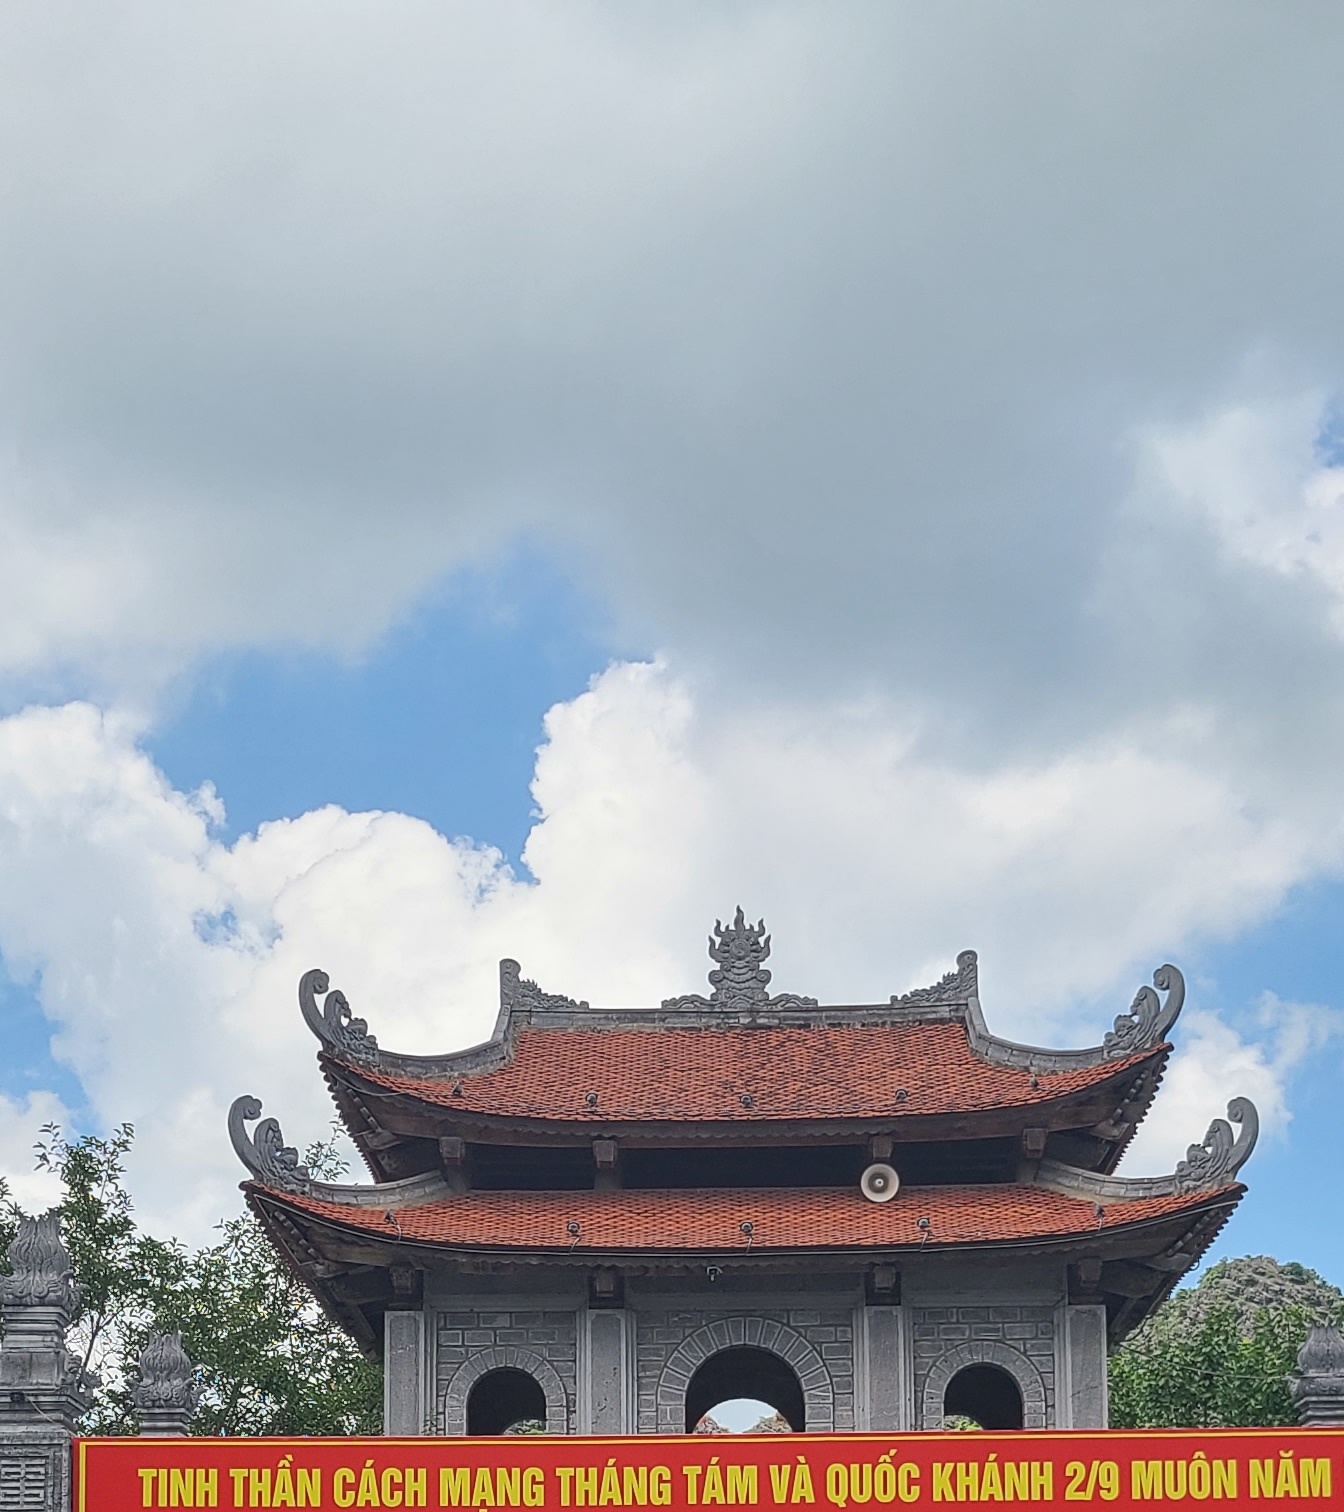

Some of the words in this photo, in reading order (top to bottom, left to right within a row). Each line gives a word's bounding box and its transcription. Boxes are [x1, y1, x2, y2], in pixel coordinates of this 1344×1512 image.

[138, 1468, 218, 1507] TINH
[229, 1455, 321, 1507] THẦN
[333, 1459, 427, 1507] CÁCH
[555, 1457, 671, 1506] THÁNG
[682, 1456, 758, 1505] TÁM
[770, 1455, 815, 1503] VÀ
[826, 1450, 920, 1507] QUỐC
[933, 1453, 1053, 1501] KHÁNH
[1065, 1461, 1119, 1500] 2/9
[1131, 1451, 1237, 1499] MUÔN
[1249, 1450, 1331, 1498] NĂM
